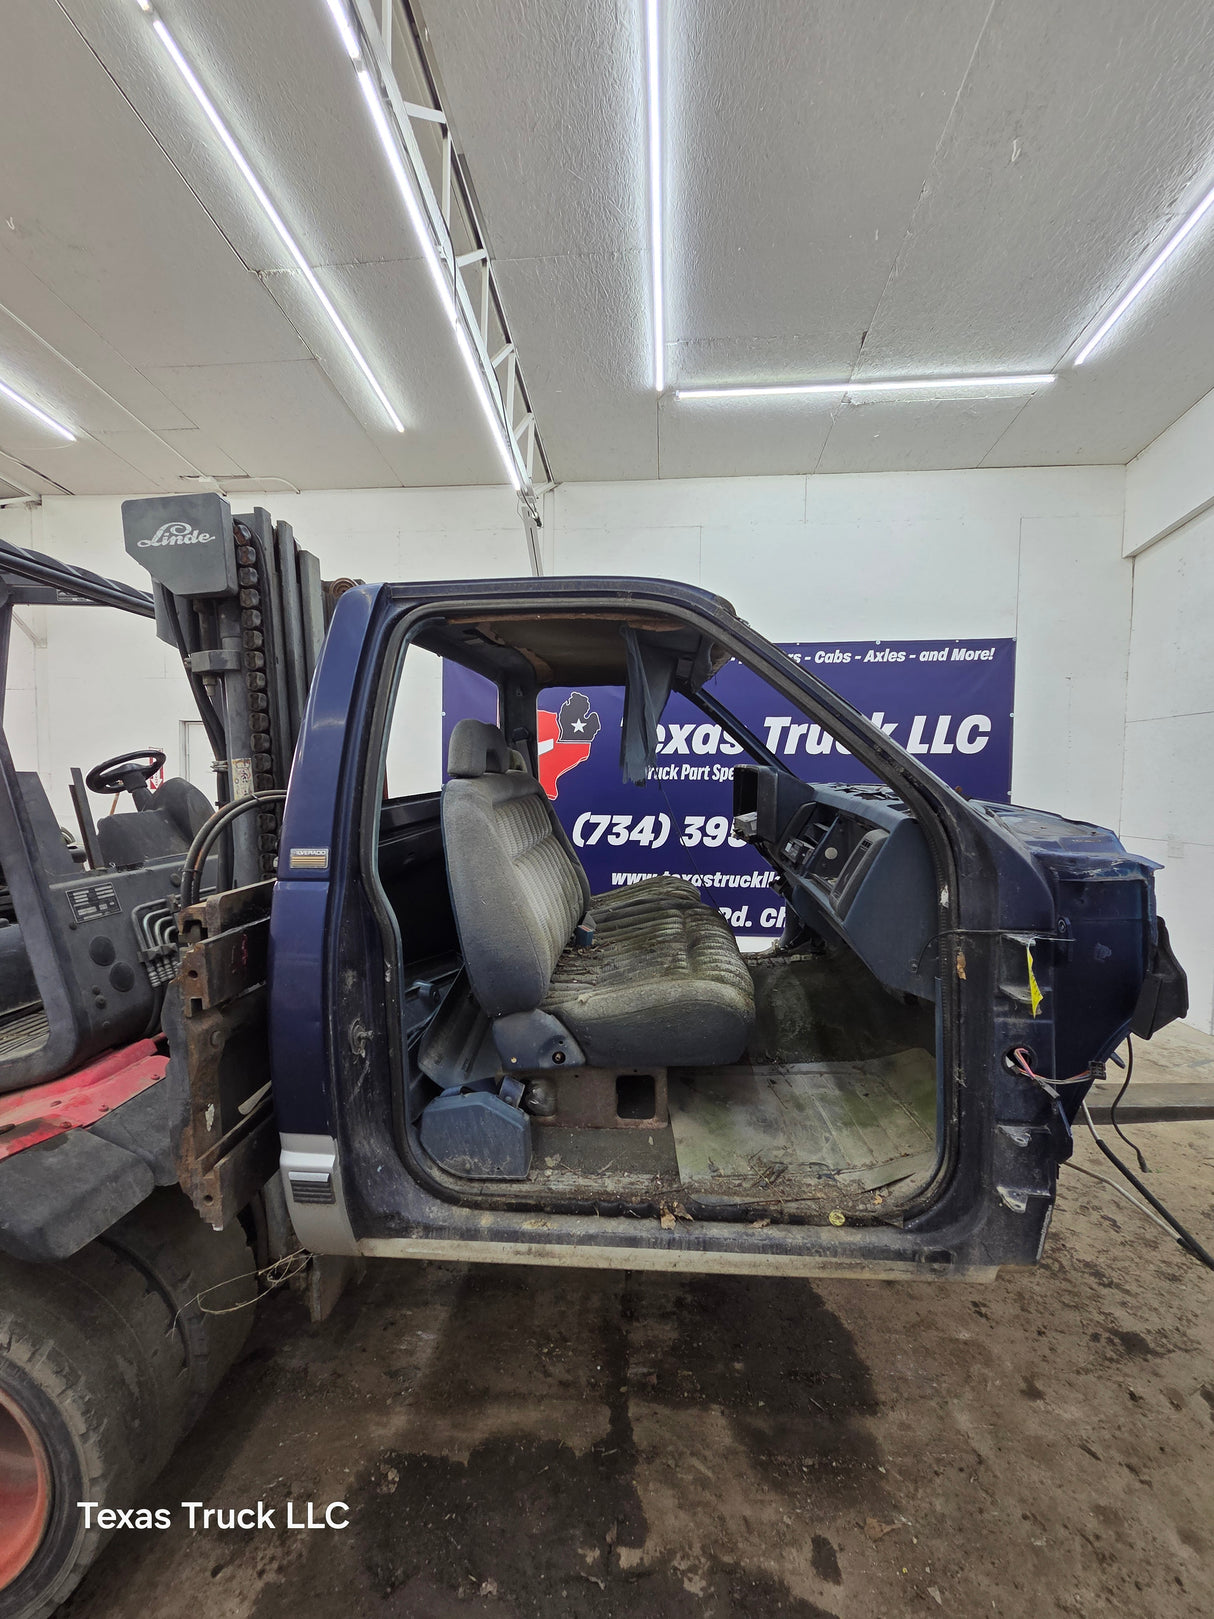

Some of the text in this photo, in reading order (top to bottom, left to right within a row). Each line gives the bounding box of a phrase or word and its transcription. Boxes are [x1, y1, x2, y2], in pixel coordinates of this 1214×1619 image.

[137, 522, 215, 547] Linde
[815, 650, 851, 664] Cabs
[863, 649, 905, 663] Axles
[919, 648, 947, 662] and
[951, 648, 995, 661] More!
[620, 711, 992, 755] exas Truk LLC
[680, 764, 711, 780] Part
[572, 811, 671, 849] (734)
